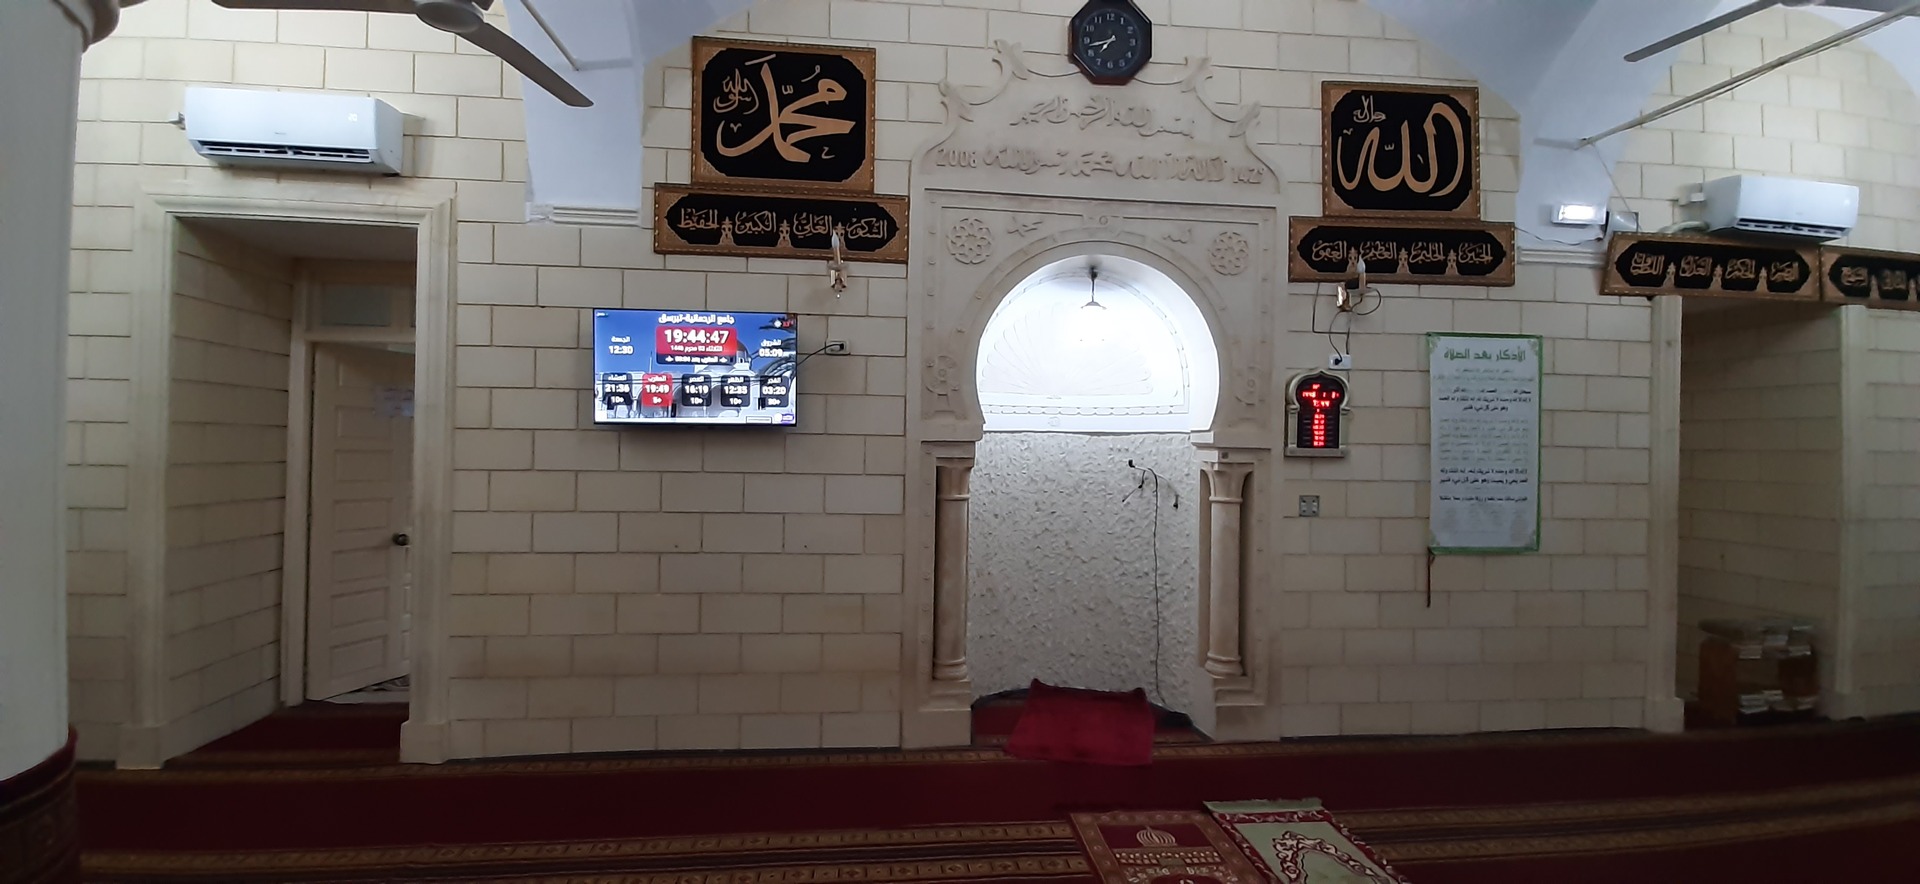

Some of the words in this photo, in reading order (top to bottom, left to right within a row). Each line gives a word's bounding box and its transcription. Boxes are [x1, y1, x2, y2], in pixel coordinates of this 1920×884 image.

[1337, 102, 1464, 197] الله
[936, 148, 978, 169] 2008
[664, 328, 729, 343] 19:44:47
[608, 345, 633, 354] 12:30
[758, 348, 784, 357] 05:09
[1444, 347, 1470, 360] الصلاة
[1474, 350, 1491, 359] بعد
[604, 384, 630, 393] 21:36
[644, 384, 670, 394] 19:49
[684, 384, 709, 394] 16:19
[723, 386, 748, 395] 12:35
[762, 386, 787, 395] 03:20
